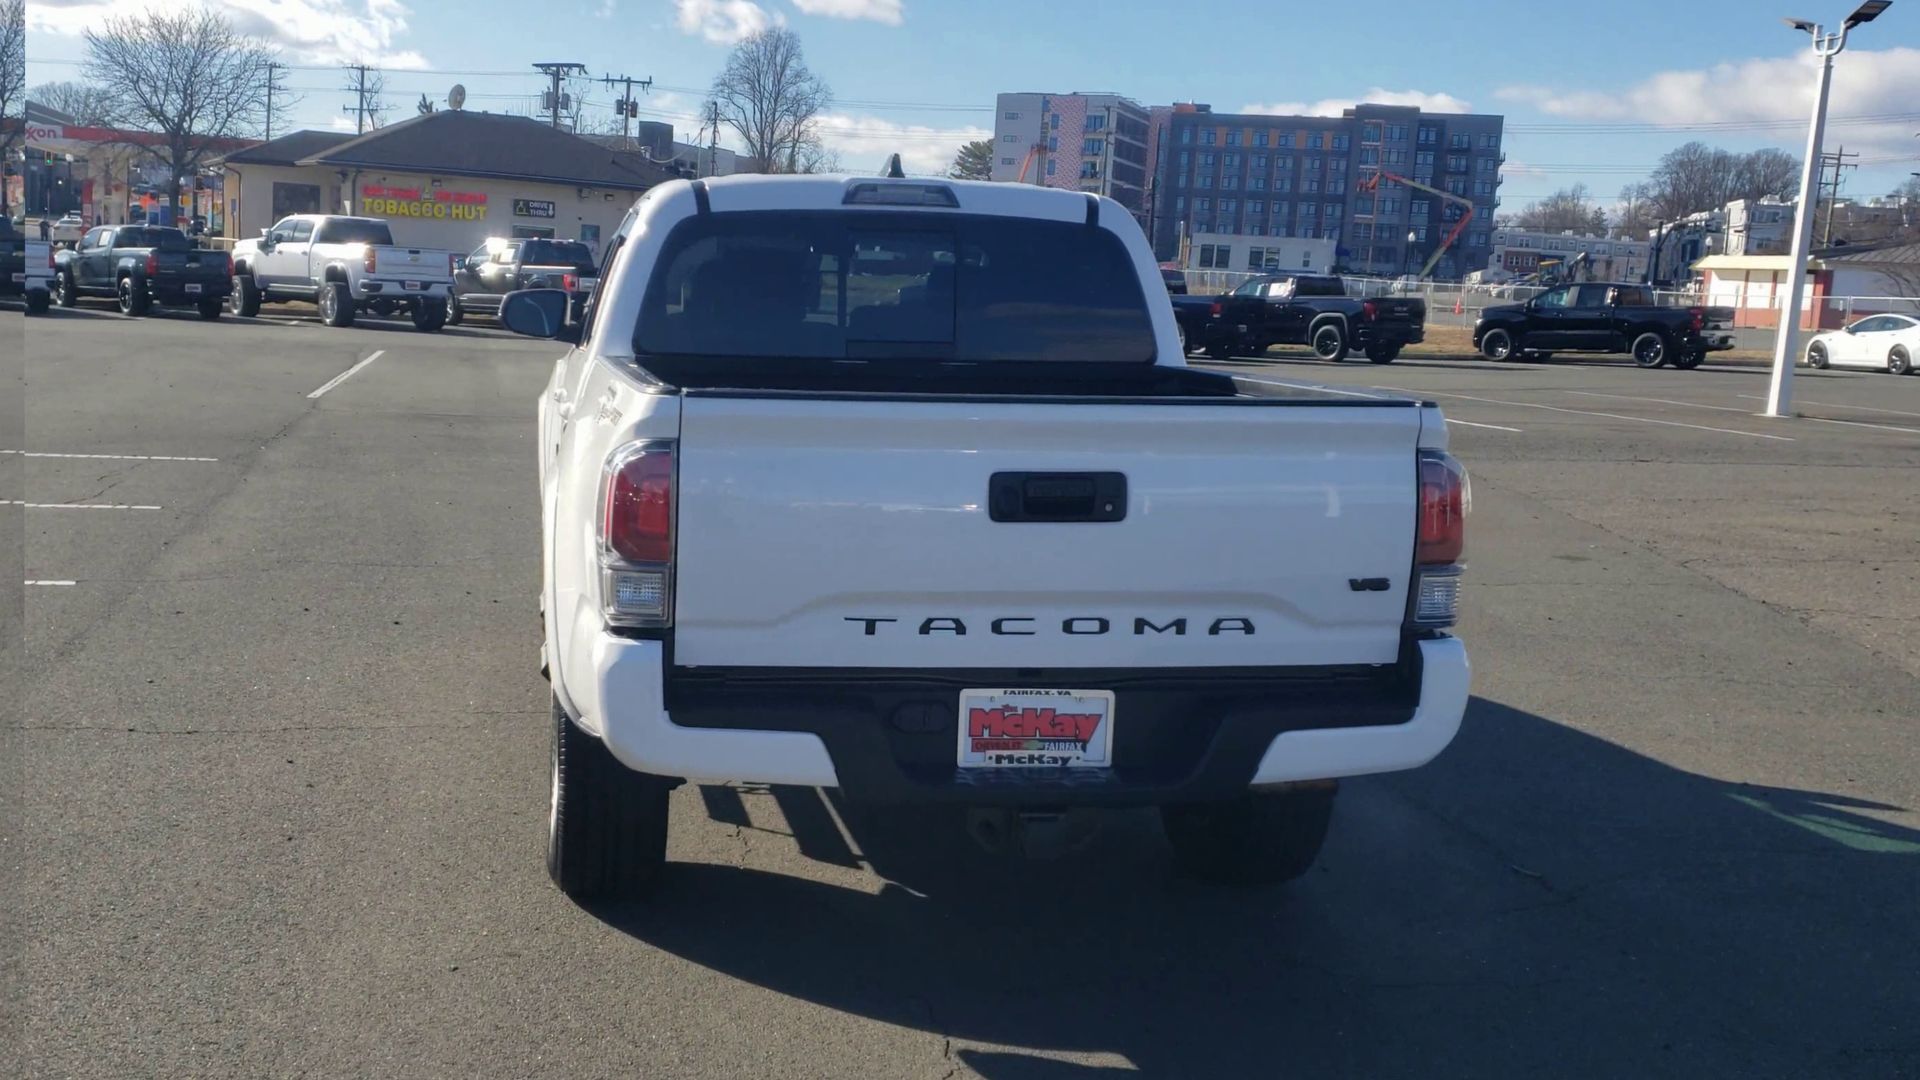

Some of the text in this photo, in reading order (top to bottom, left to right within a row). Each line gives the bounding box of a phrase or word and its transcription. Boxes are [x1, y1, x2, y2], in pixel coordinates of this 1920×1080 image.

[362, 197, 446, 218] TOBACCO
[451, 203, 487, 220] HUT
[529, 201, 548, 209] DRIVE
[530, 209, 547, 217] THRU
[1348, 577, 1391, 591] V6
[844, 617, 1256, 635] TACOMA
[968, 707, 1103, 744] McKay
[1044, 741, 1083, 752] FAIRFAX
[994, 754, 1072, 766] McKay
